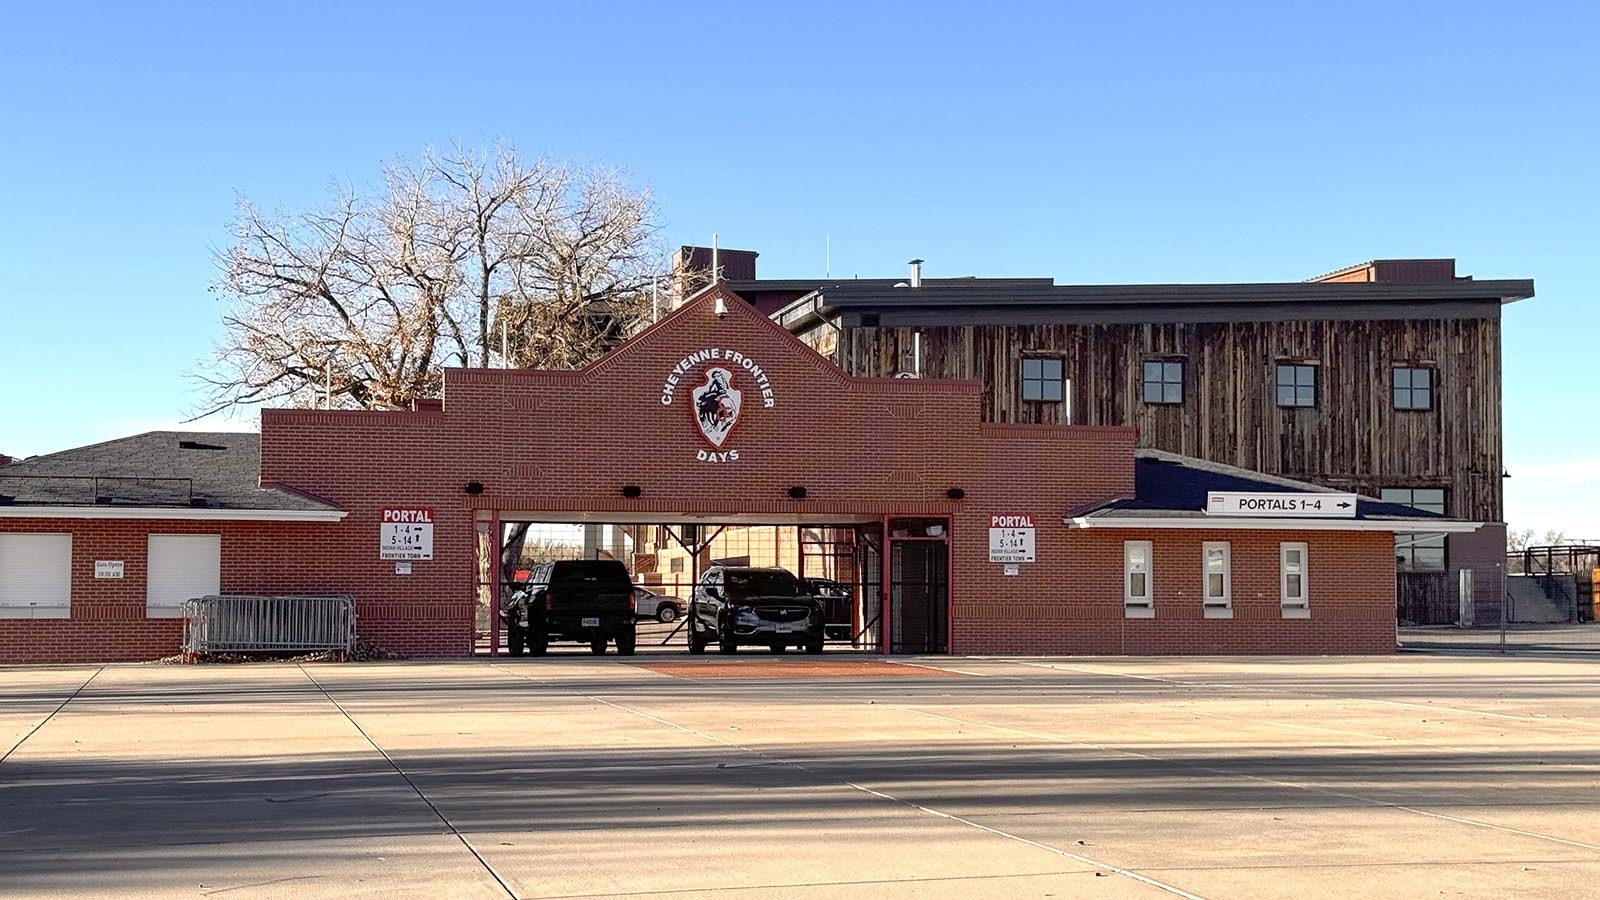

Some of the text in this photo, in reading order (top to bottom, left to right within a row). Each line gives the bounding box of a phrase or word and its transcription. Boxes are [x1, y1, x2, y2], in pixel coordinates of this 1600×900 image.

[660, 348, 775, 408] CHEYENNE FRONTIER
[696, 449, 740, 463] DAYS
[1239, 498, 1297, 510] PORTALS
[383, 510, 432, 522] PORTAL
[992, 516, 1034, 527] PORTAL
